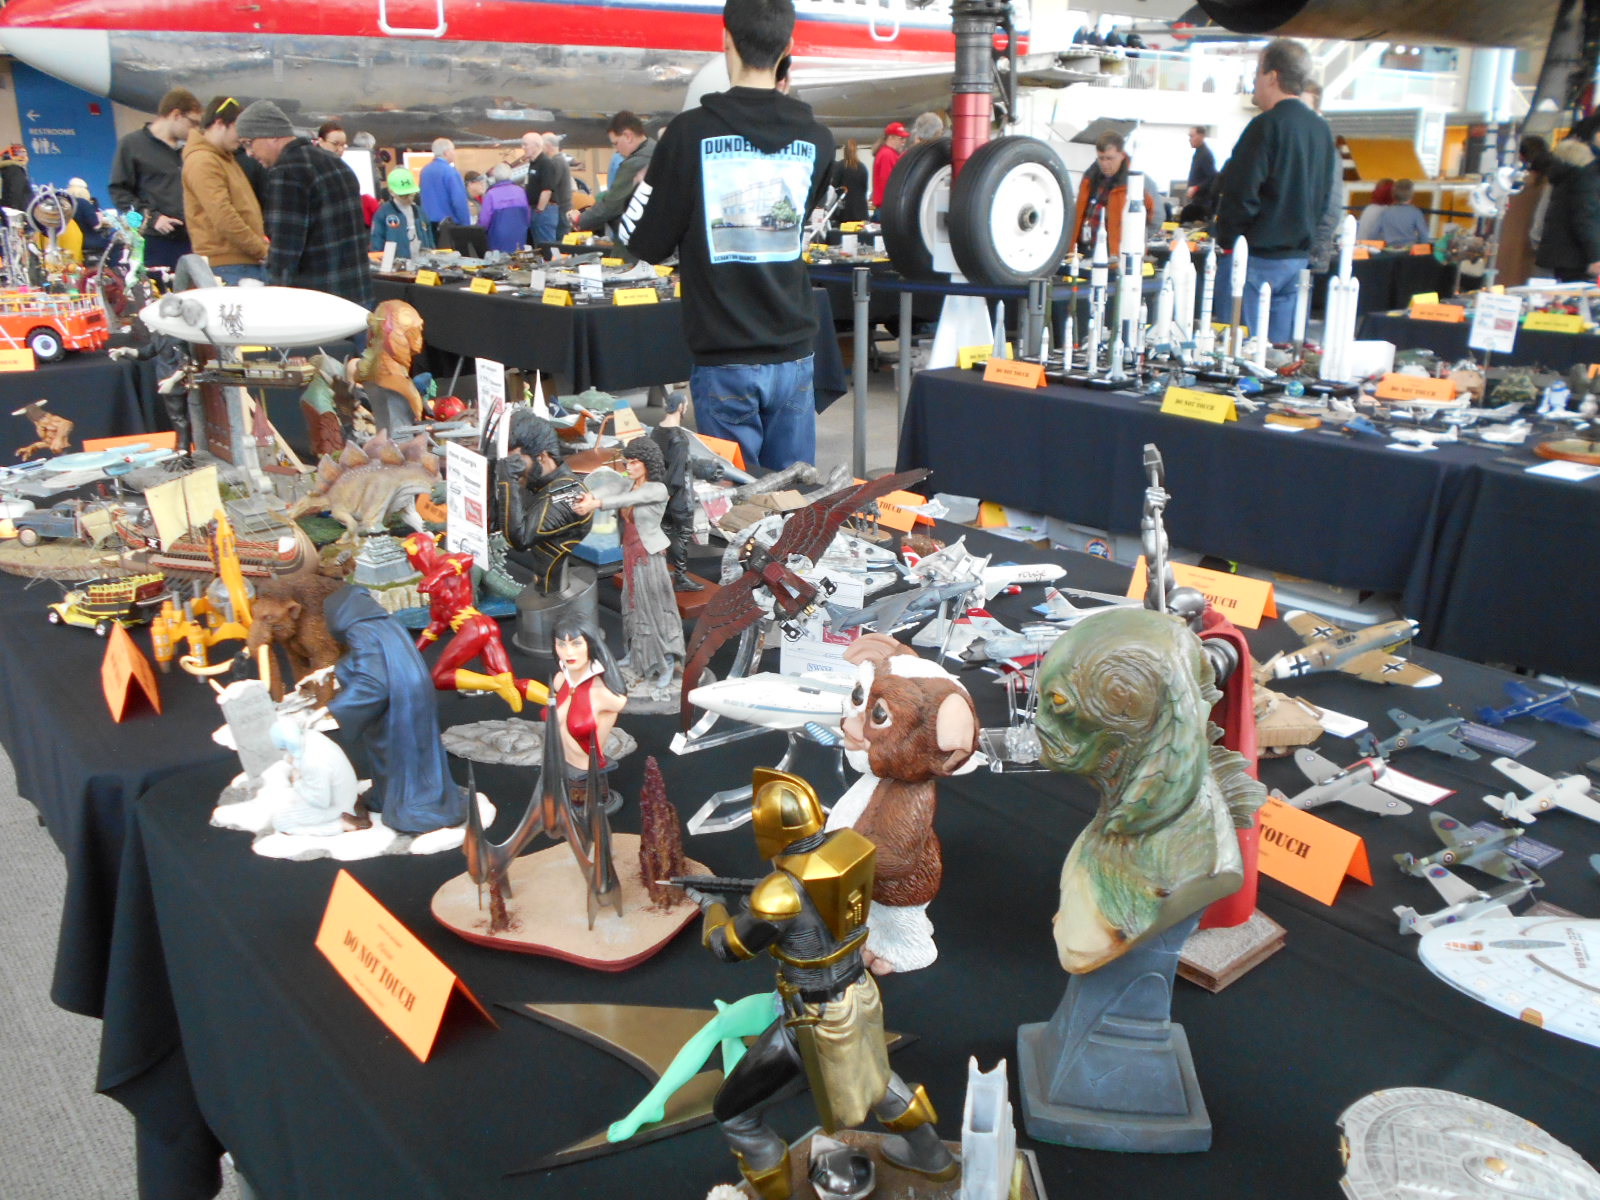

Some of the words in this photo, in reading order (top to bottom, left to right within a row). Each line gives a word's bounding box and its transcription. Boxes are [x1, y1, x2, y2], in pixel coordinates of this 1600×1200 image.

[29, 128, 76, 136] RESTROOMS
[1203, 592, 1238, 609] OUCH
[344, 929, 359, 953] DO
[358, 944, 381, 974] NOT
[379, 966, 416, 1012] TOUCH
